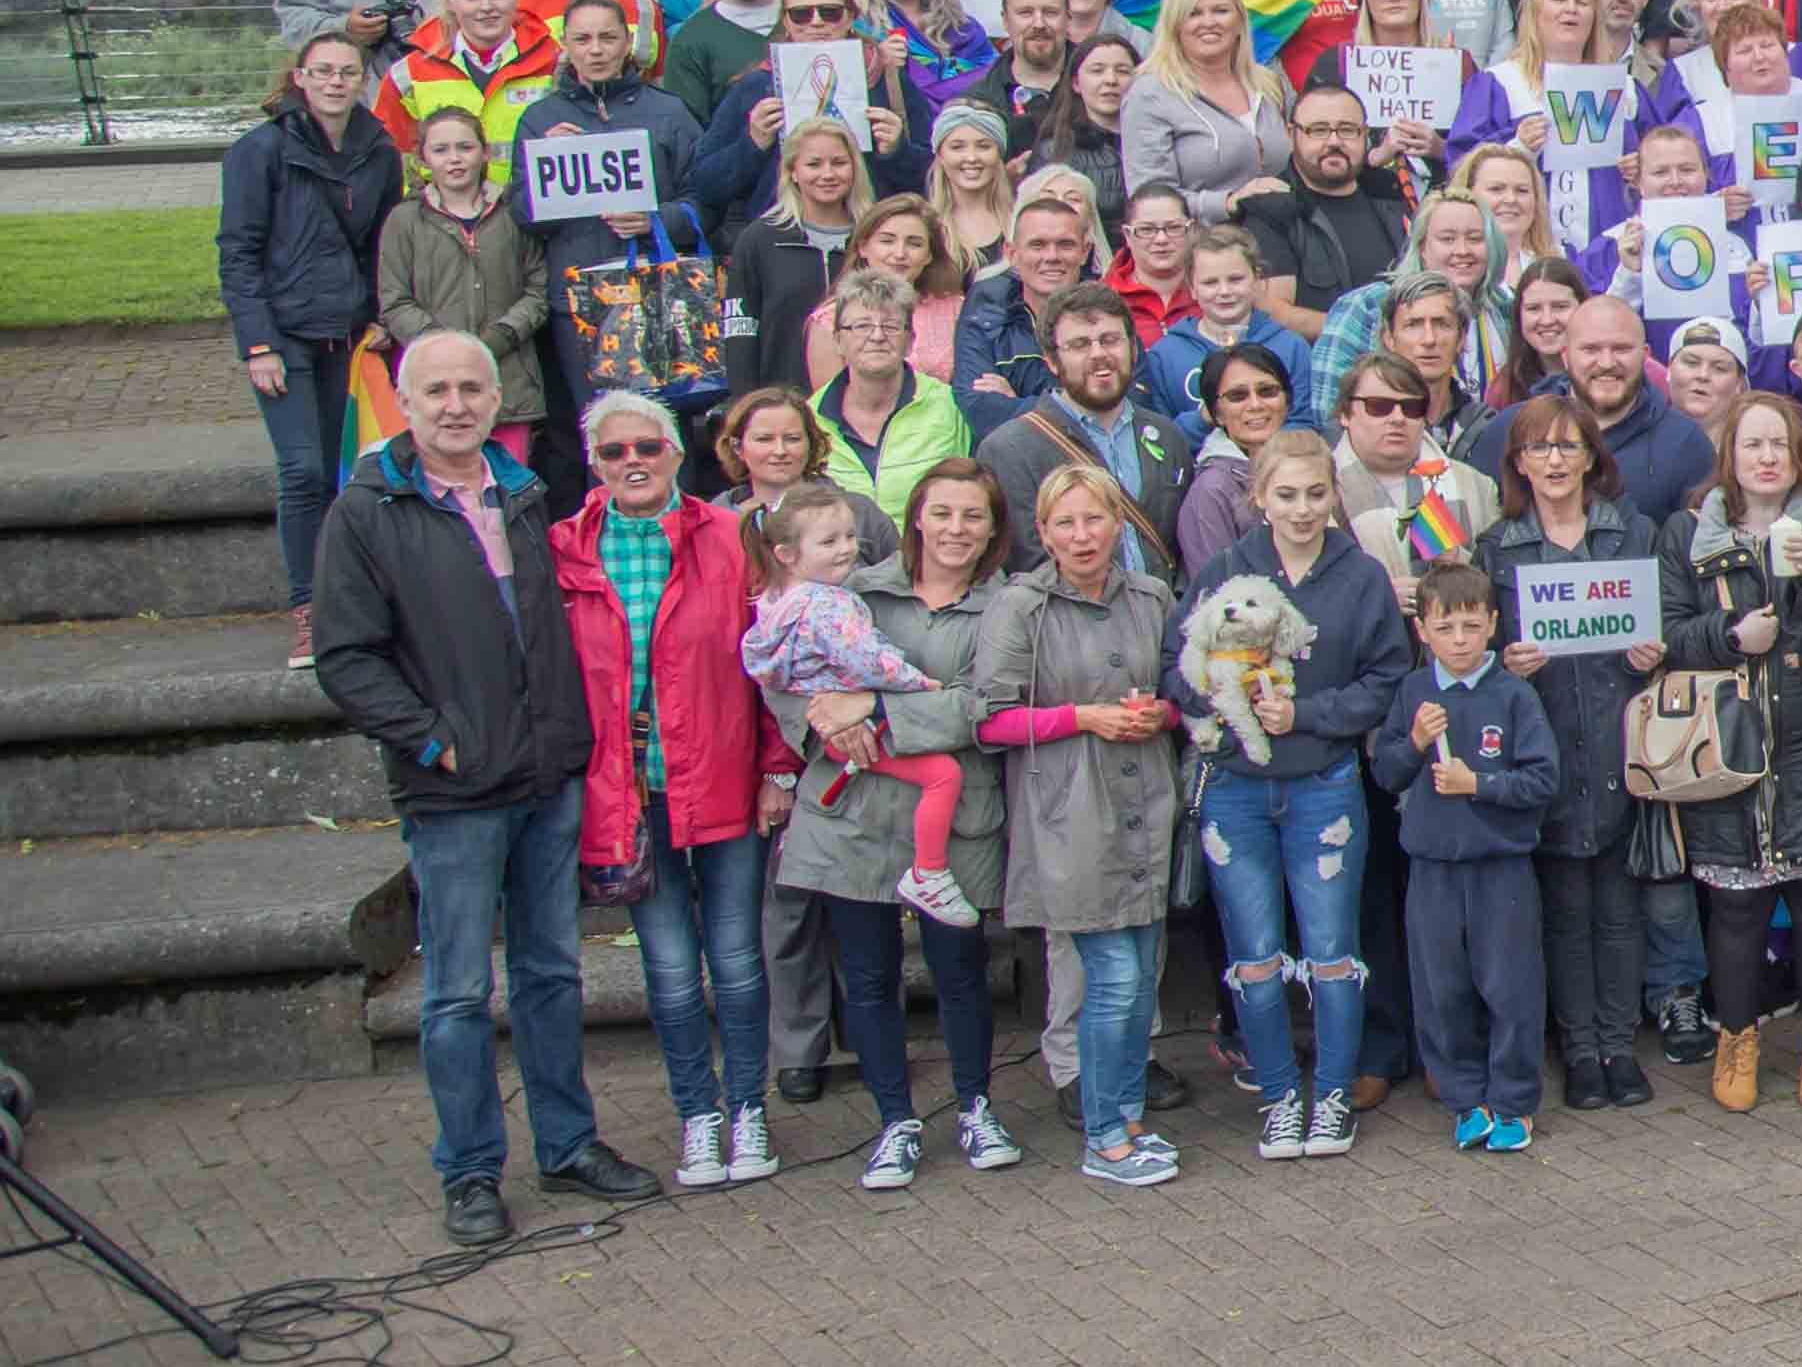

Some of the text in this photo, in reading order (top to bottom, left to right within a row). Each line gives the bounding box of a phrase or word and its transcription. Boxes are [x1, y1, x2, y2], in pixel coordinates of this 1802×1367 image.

[1356, 48, 1414, 71] LOVE
[1367, 74, 1415, 95] NOT
[1379, 99, 1435, 120] HATE
[536, 149, 644, 198] PULSE
[1530, 579, 1632, 603] WE ARE
[1532, 613, 1636, 641] ORLANDO
